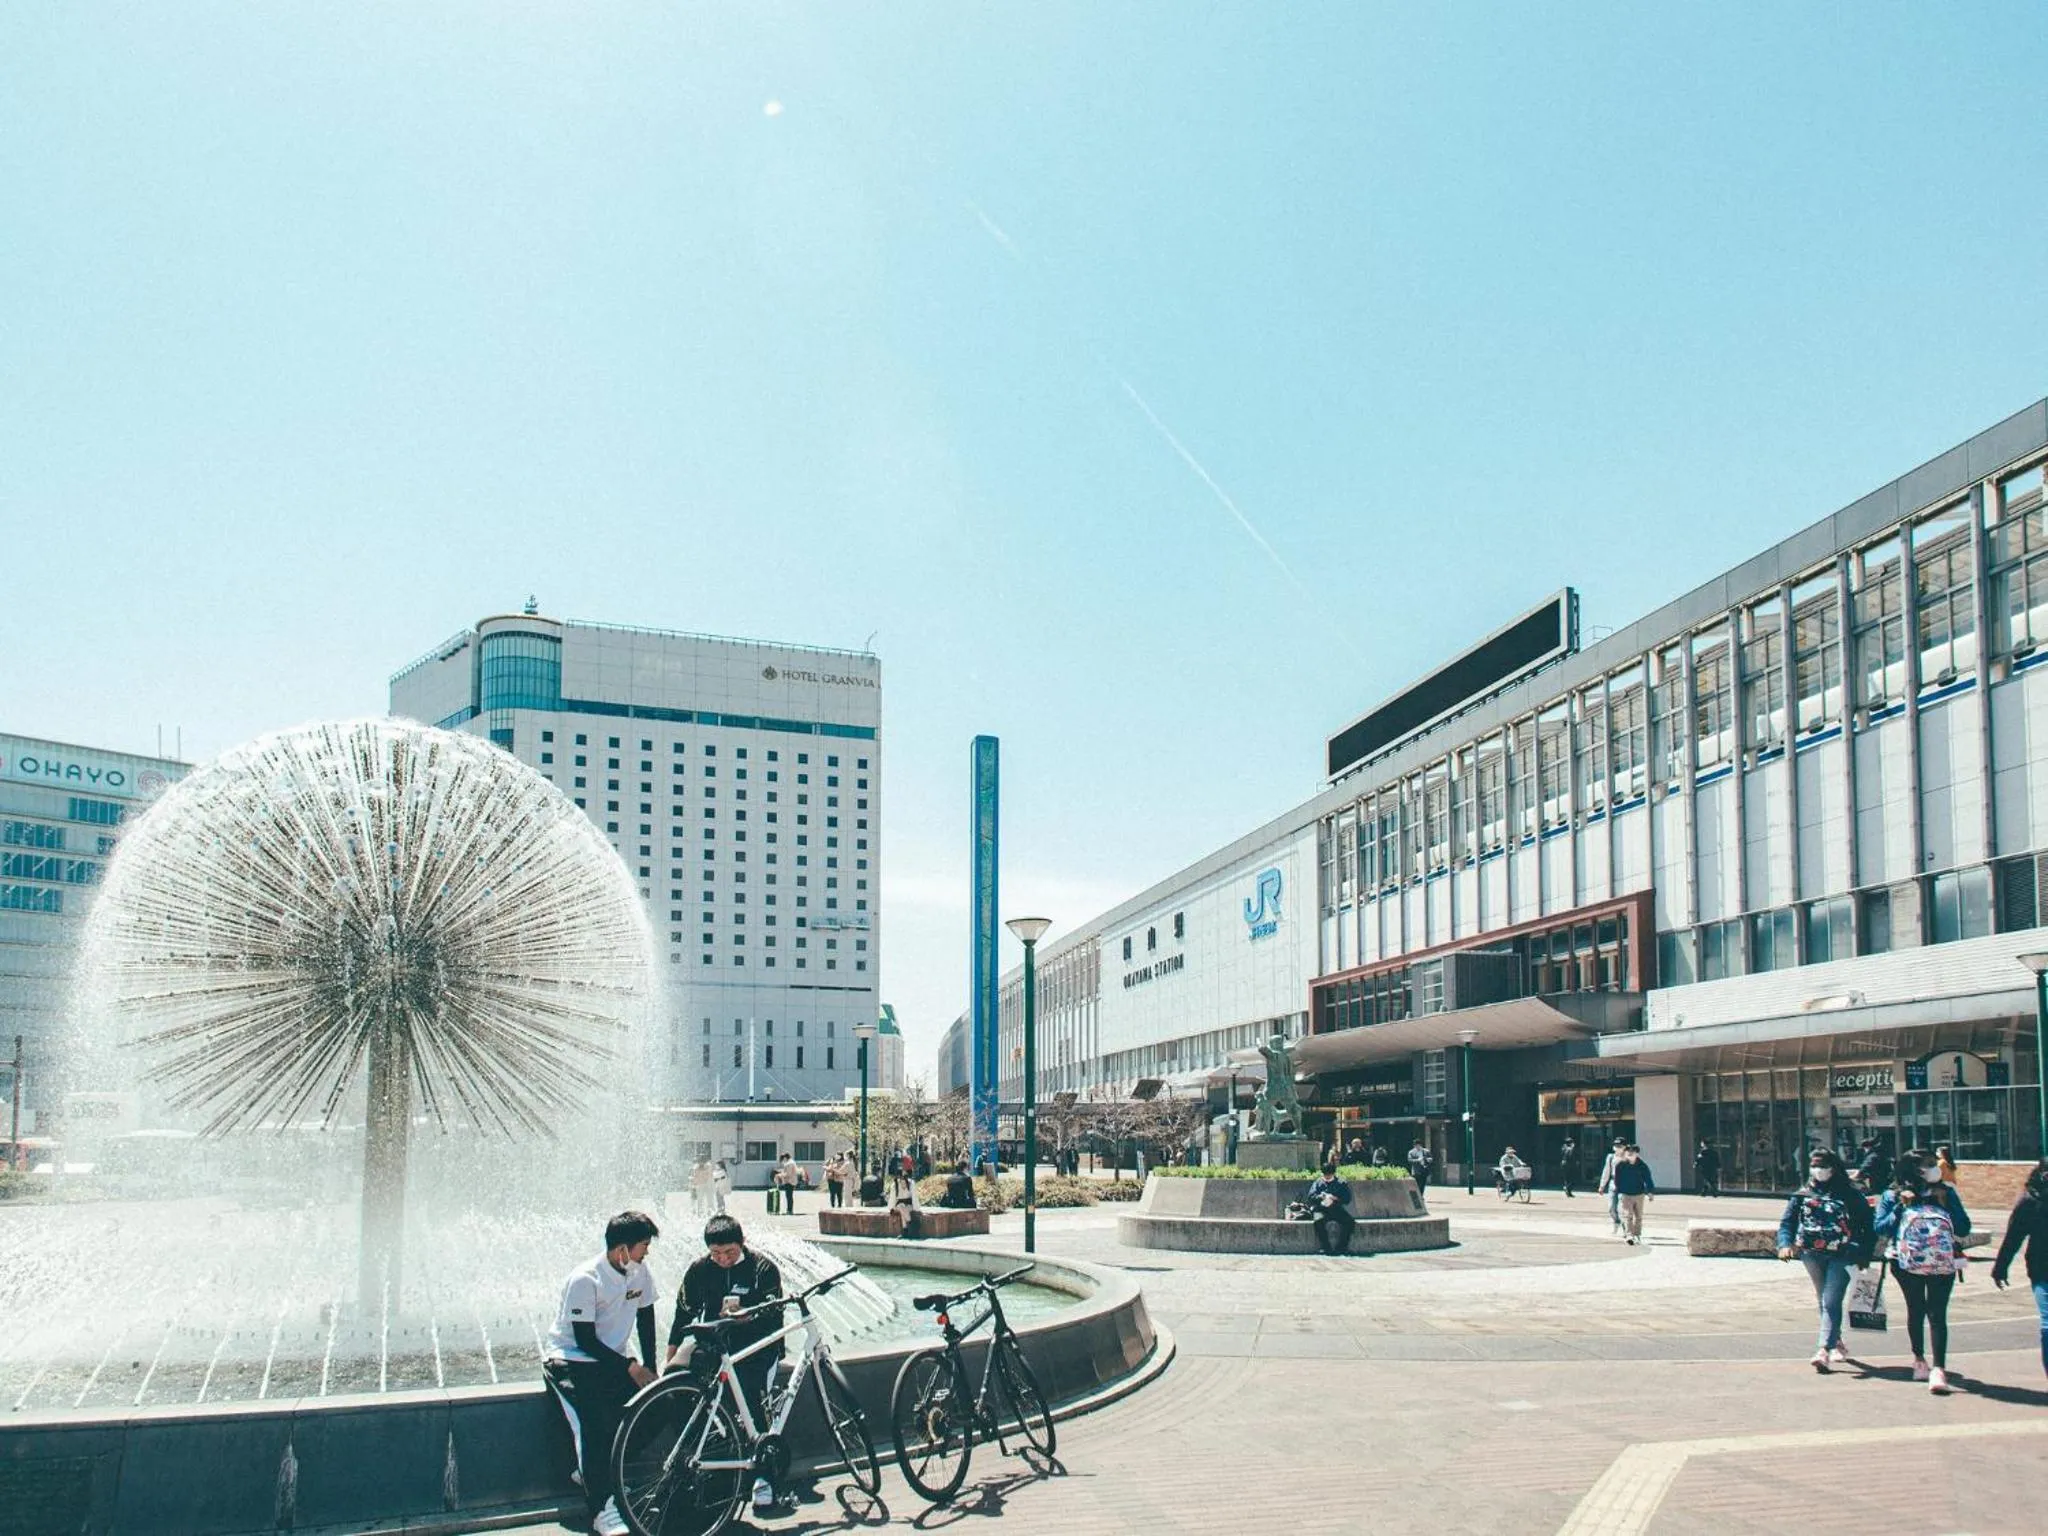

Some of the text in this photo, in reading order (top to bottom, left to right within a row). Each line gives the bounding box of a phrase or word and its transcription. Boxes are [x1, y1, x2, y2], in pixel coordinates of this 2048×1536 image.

[783, 670, 875, 688] HOTEL GRANVIA
[20, 757, 125, 786] OHAYO
[1244, 869, 1281, 923] JR
[1123, 952, 1184, 989] OKAYAMA STATION
